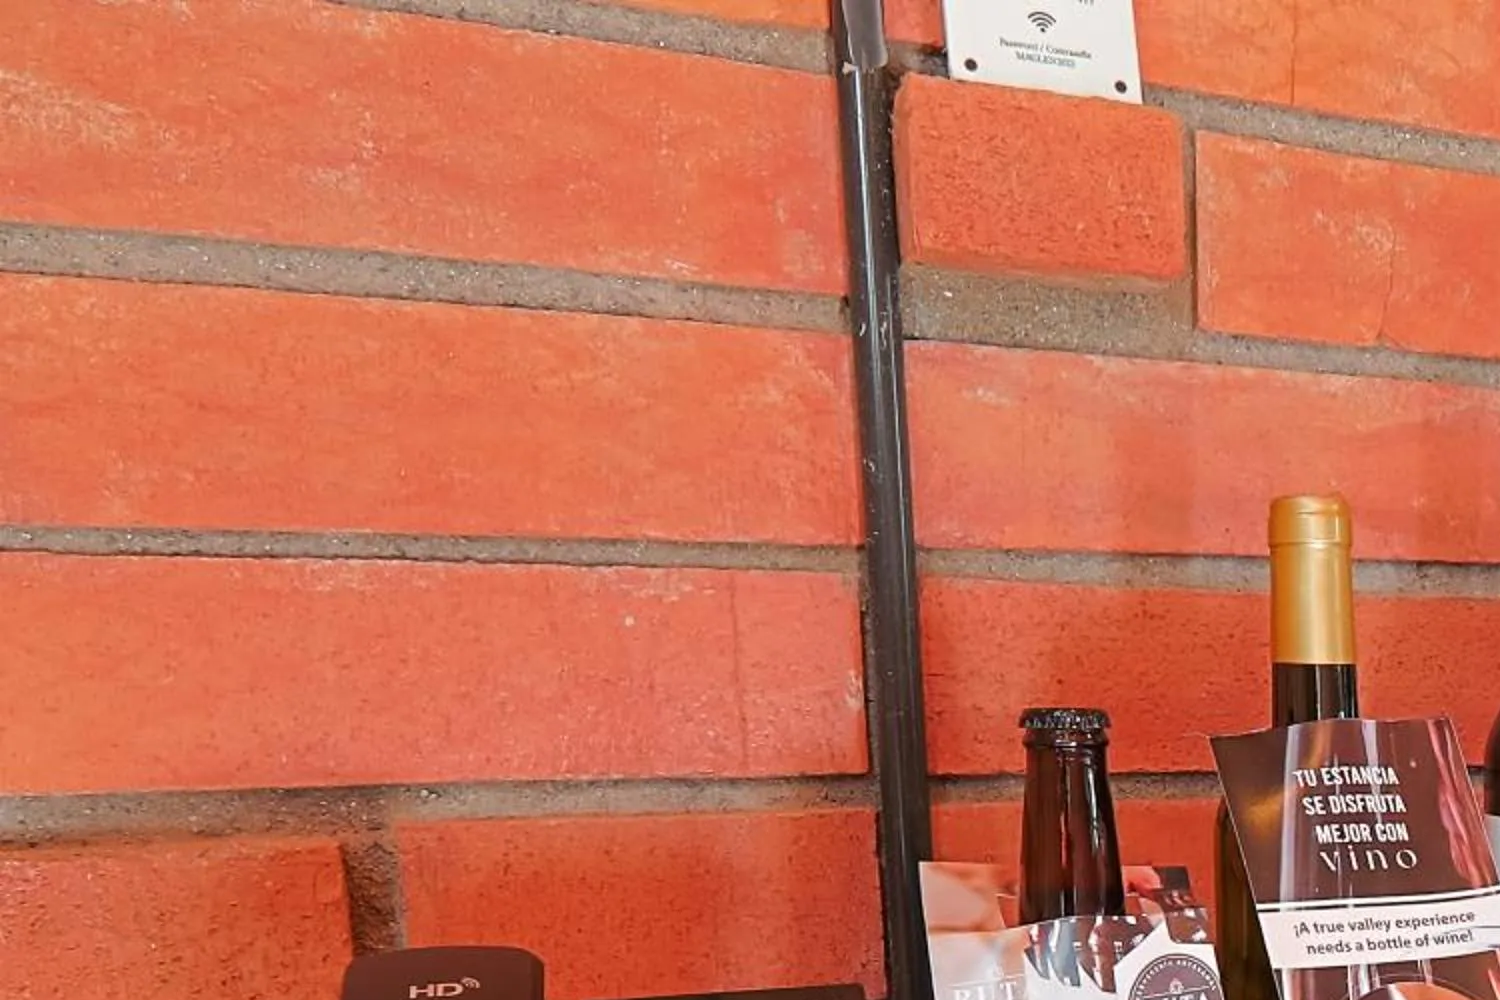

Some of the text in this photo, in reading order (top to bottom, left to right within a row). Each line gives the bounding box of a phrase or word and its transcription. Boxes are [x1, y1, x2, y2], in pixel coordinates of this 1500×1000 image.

[1292, 766, 1400, 788] TU ESTANCIA
[1302, 794, 1408, 816] SE DISFRUTA
[1315, 821, 1410, 843] MEJOR CON
[1319, 844, 1418, 871] vino
[1313, 921, 1346, 935] true
[1349, 917, 1392, 933] valley
[1395, 910, 1476, 931] experience
[1305, 928, 1474, 956] needs a bottle of wine!
[409, 983, 464, 999] HD
